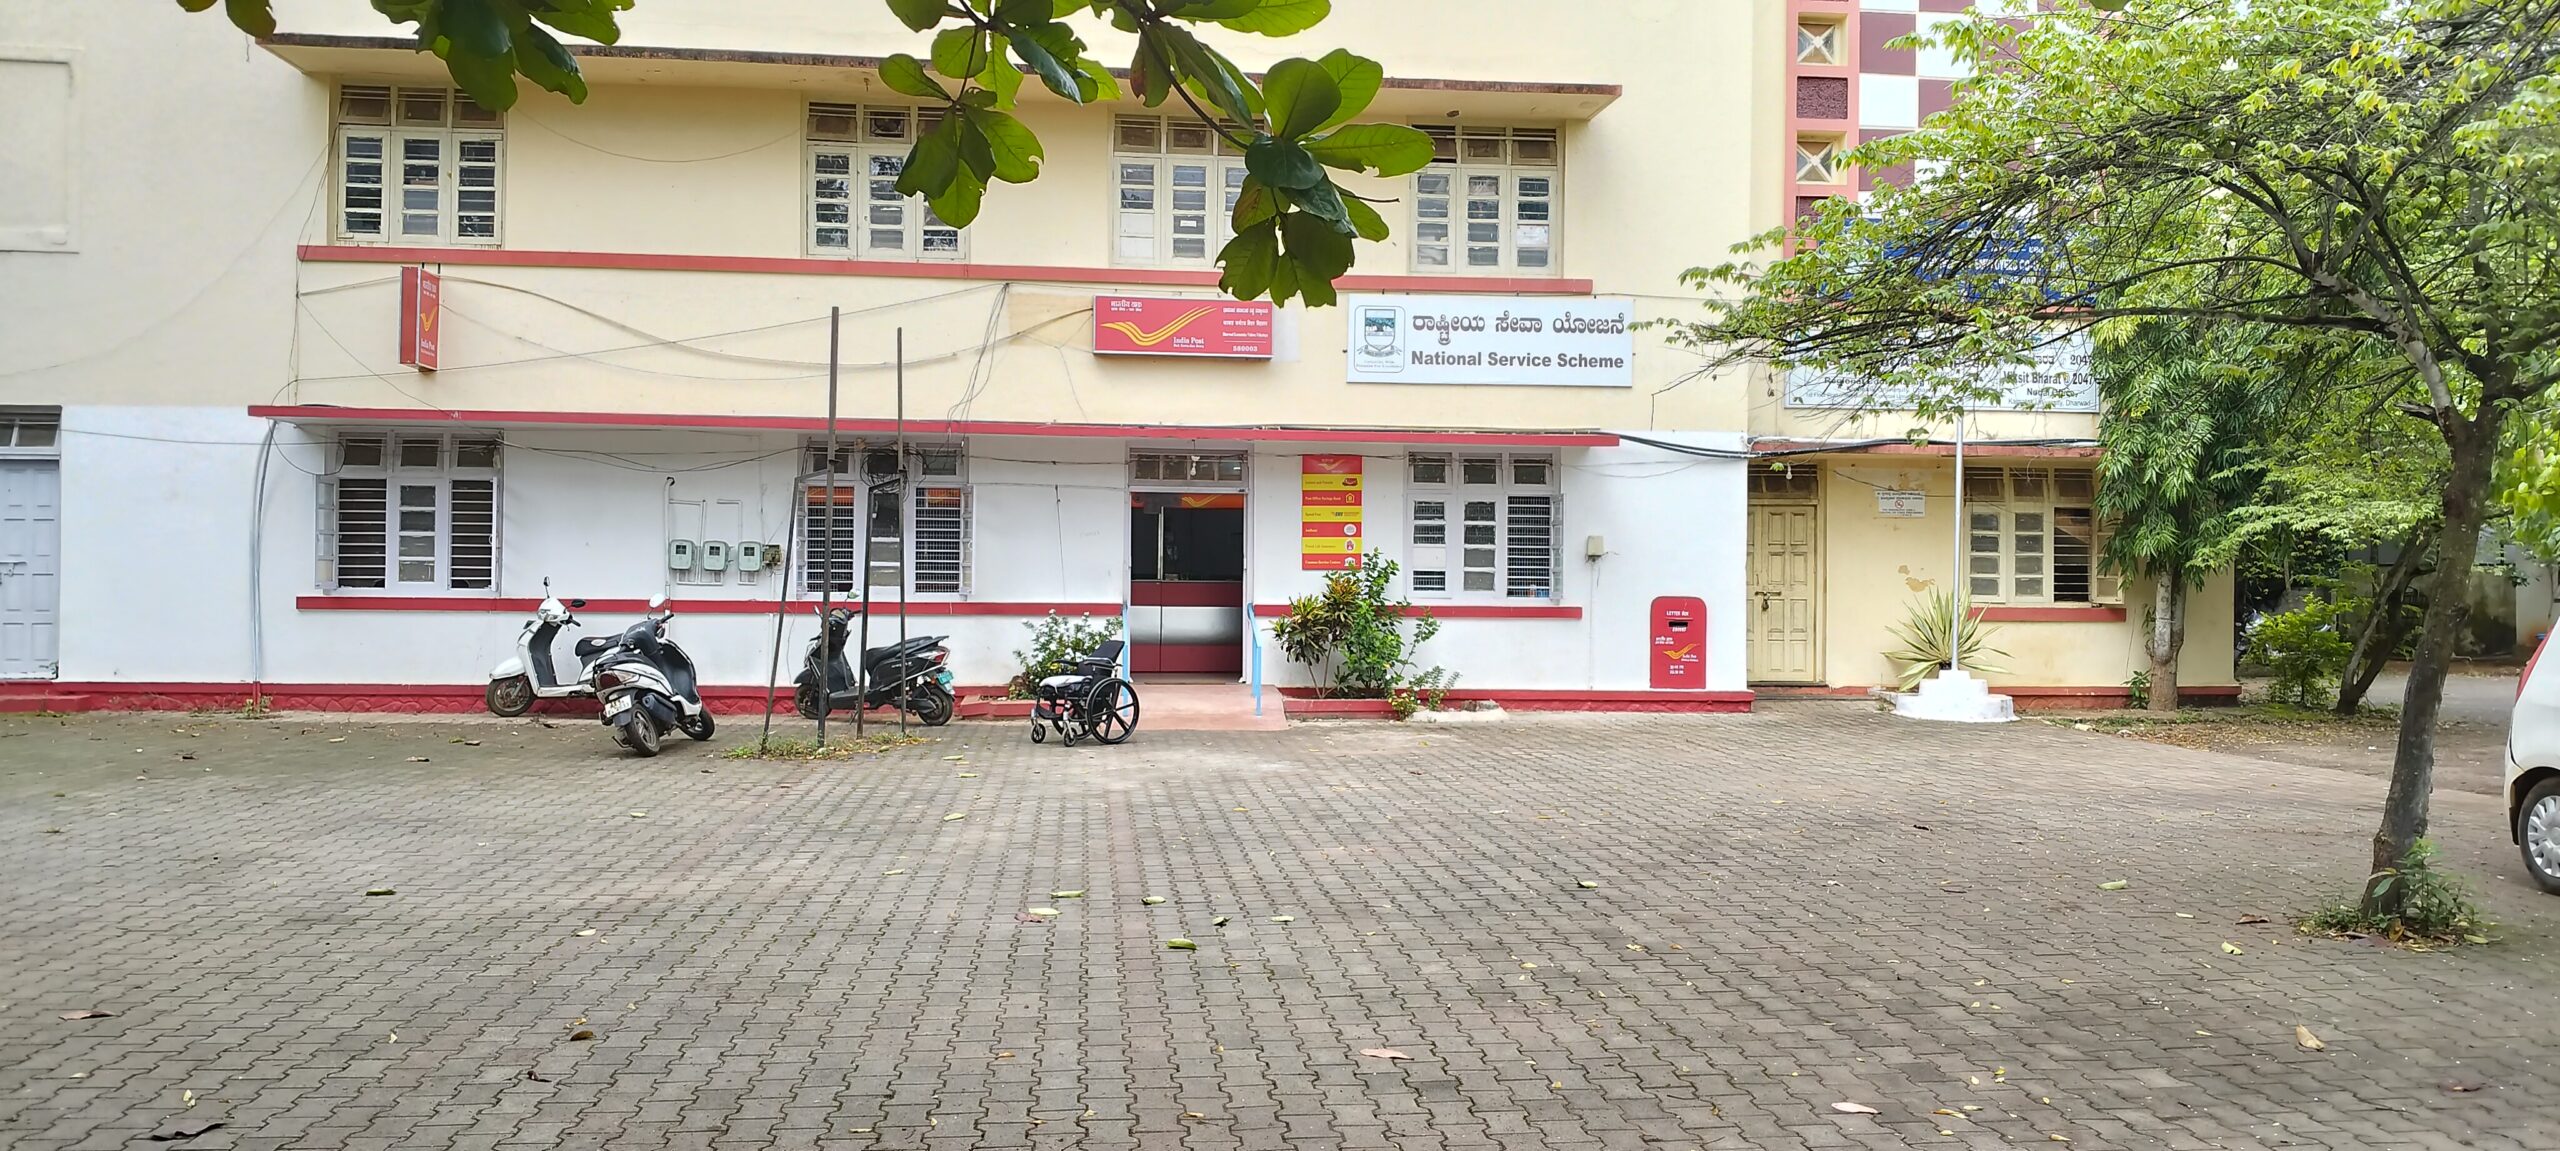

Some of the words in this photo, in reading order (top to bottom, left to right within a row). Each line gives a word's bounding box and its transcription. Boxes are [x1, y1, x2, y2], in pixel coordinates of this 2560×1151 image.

[1412, 314, 1486, 346] ರಾಷ್ಟ್ರೀಯ
[1495, 310, 1543, 333] ಸೇವಾ
[1552, 311, 1625, 335] ಯೋಜನೆ
[1173, 336, 1190, 344] India
[1190, 337, 1204, 345] Post
[1411, 350, 1482, 366] National
[1487, 351, 1552, 367] Service
[1557, 353, 1625, 368] Scheme
[2031, 371, 2062, 385] Bharat
[2072, 373, 2093, 385] 2047
